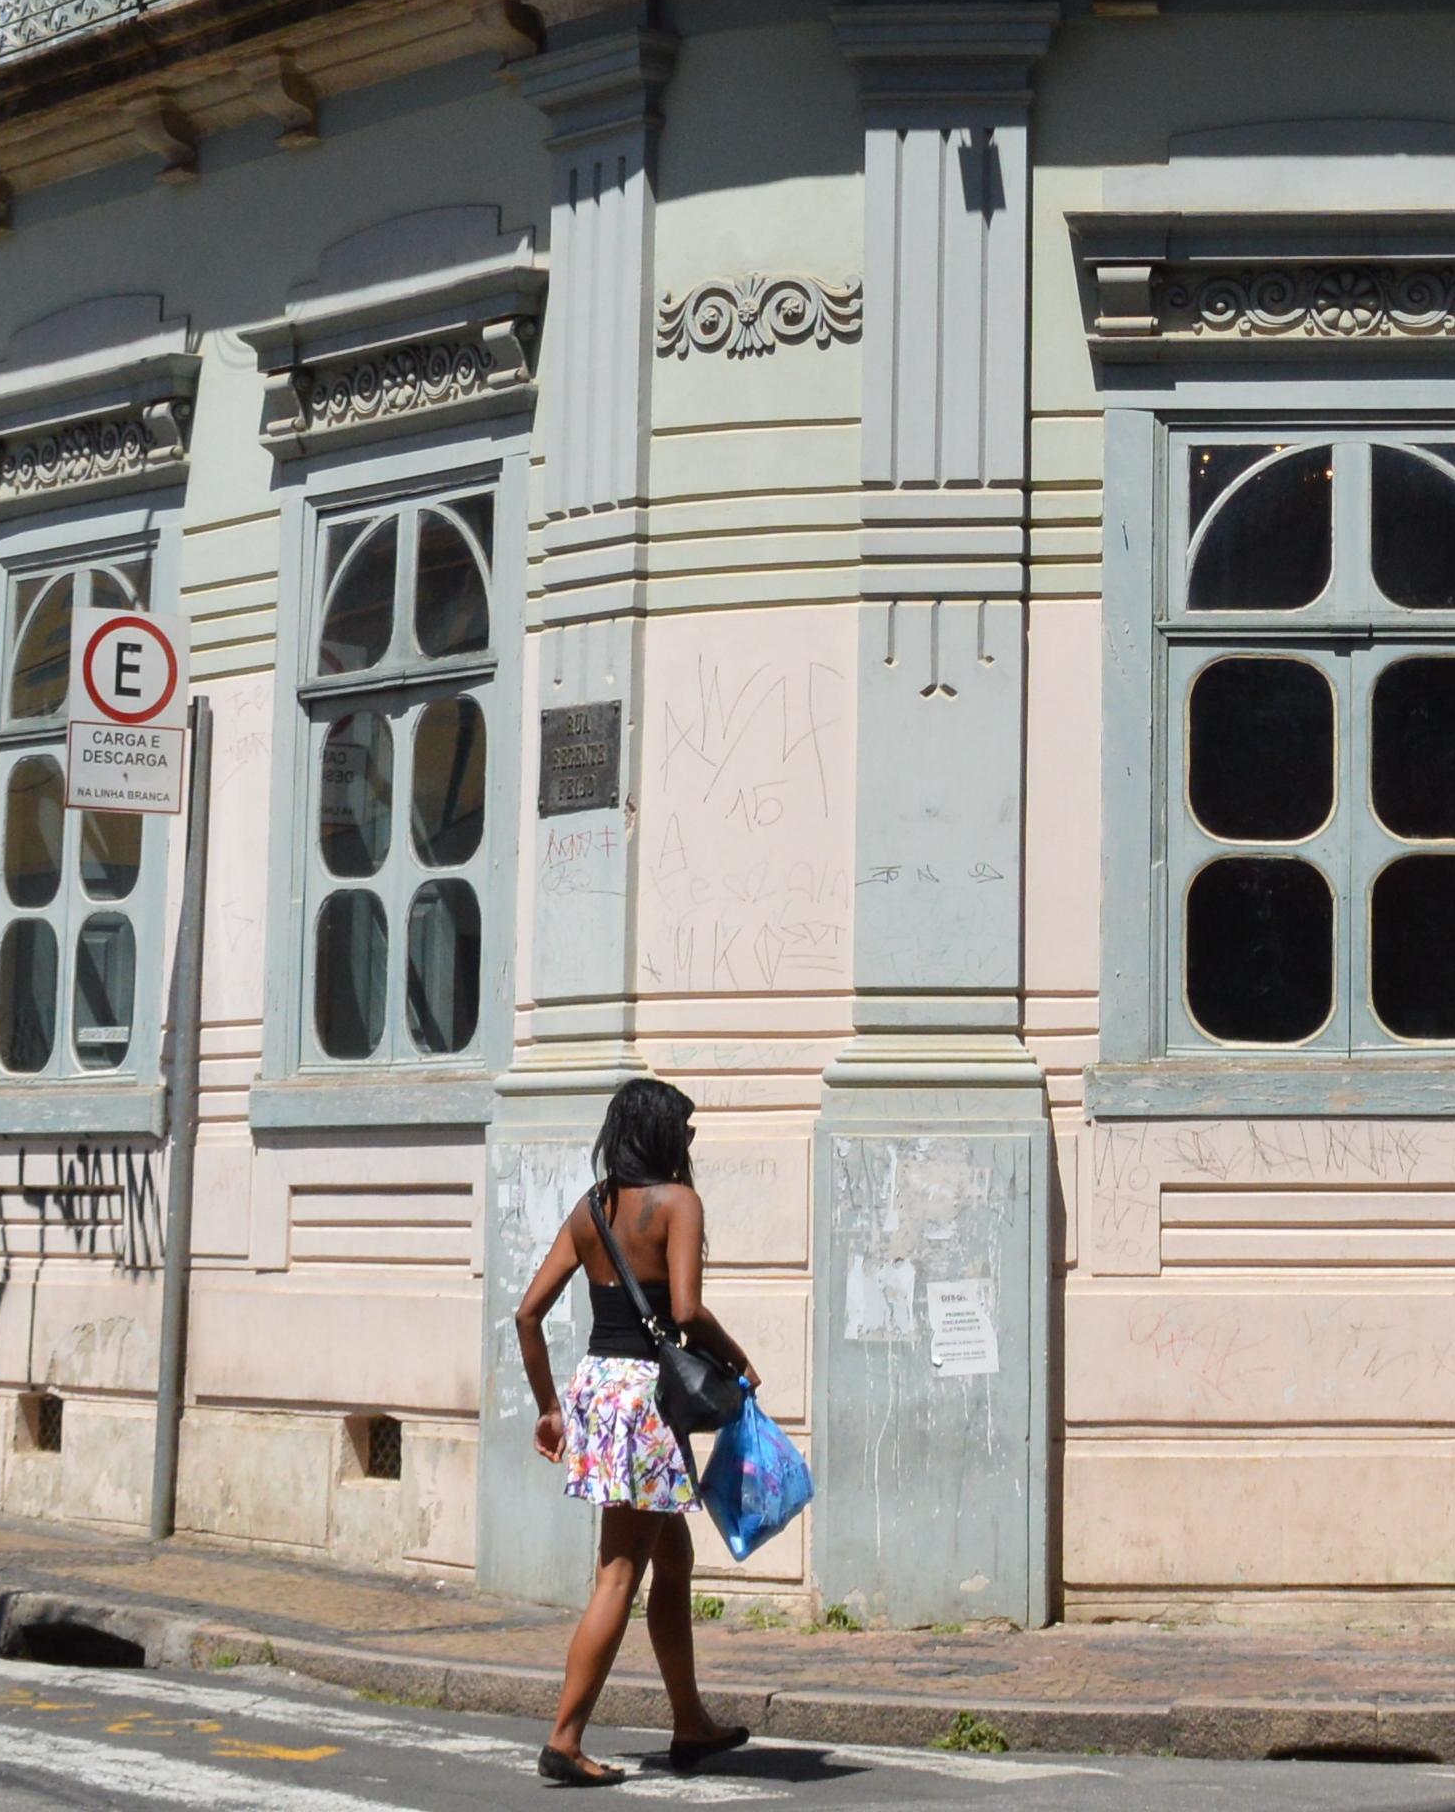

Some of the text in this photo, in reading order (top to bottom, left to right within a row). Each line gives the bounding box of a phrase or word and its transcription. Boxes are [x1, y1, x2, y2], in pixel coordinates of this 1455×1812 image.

[115, 642, 142, 697] E
[93, 731, 161, 748] CARGA E
[82, 750, 169, 767] DESCARGA
[77, 788, 170, 802] NA LINHA BRANCA
